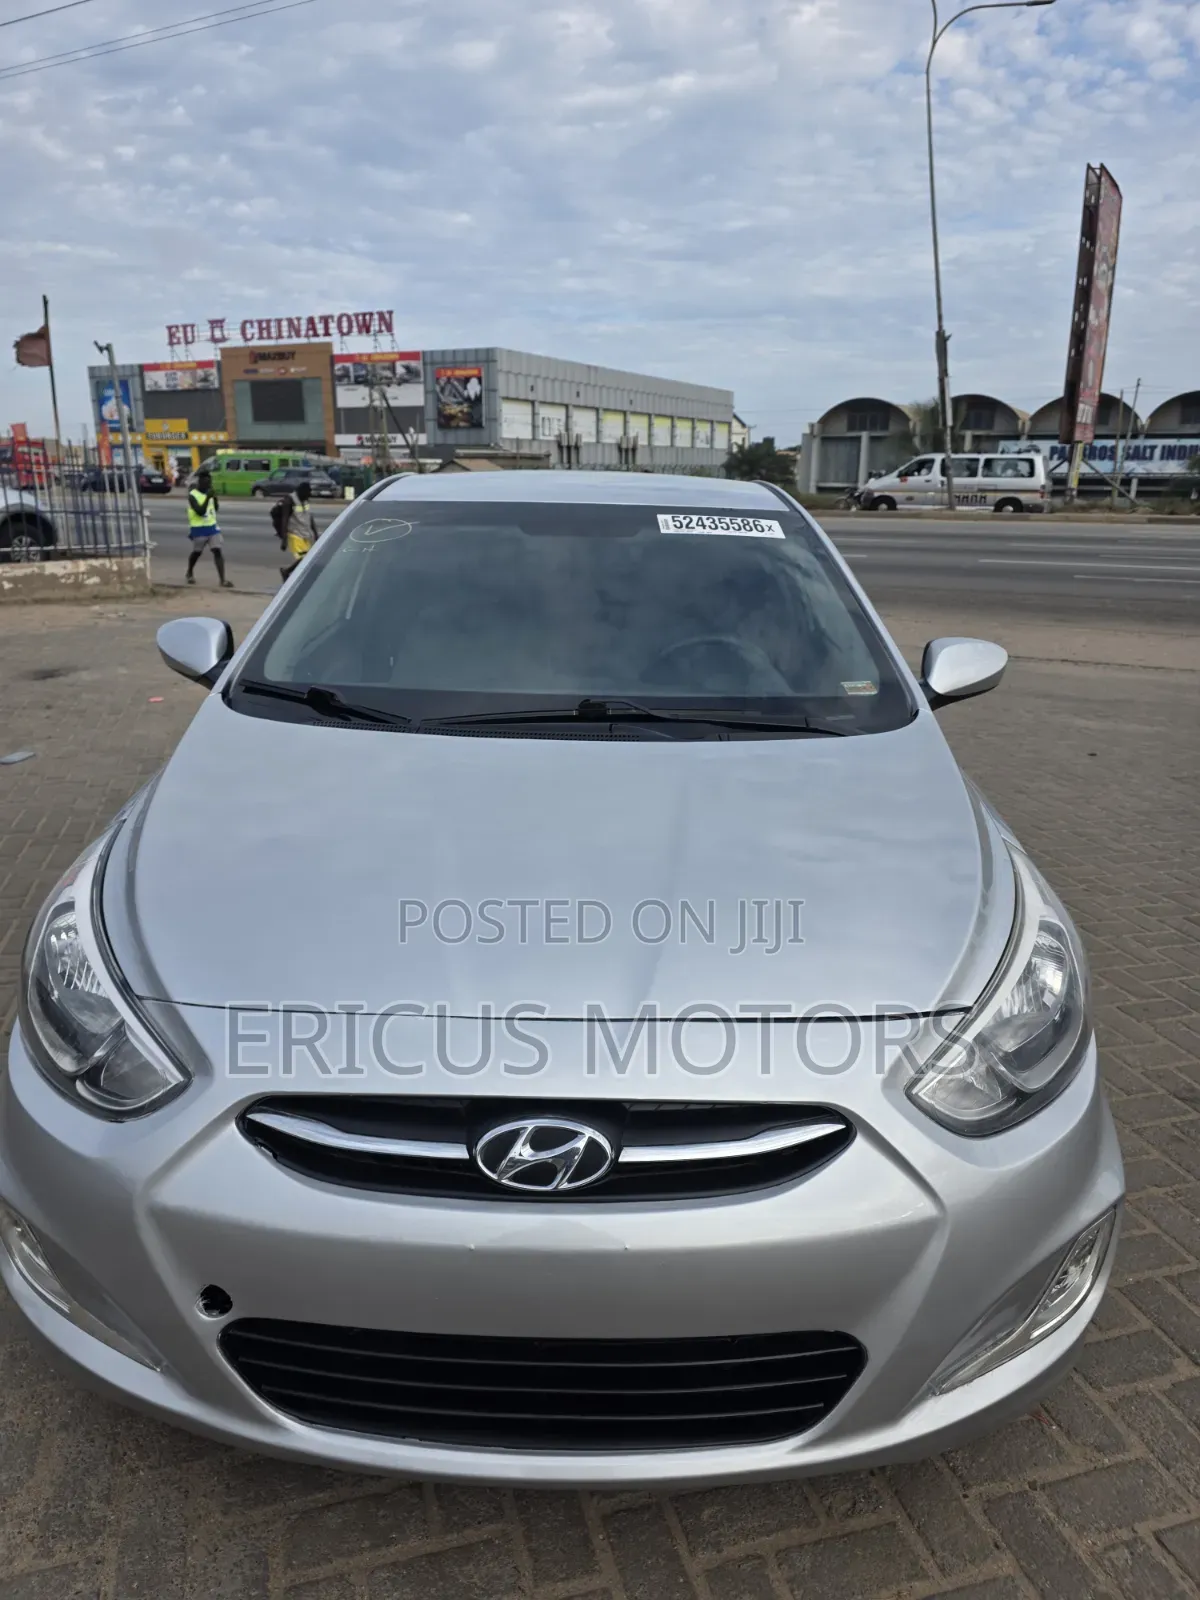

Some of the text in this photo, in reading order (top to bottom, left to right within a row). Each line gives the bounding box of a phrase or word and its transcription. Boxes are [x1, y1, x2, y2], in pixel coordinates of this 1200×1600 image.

[166, 310, 394, 346] EU CHINATOWN
[1049, 444, 1200, 461] PAROS SALT INDU
